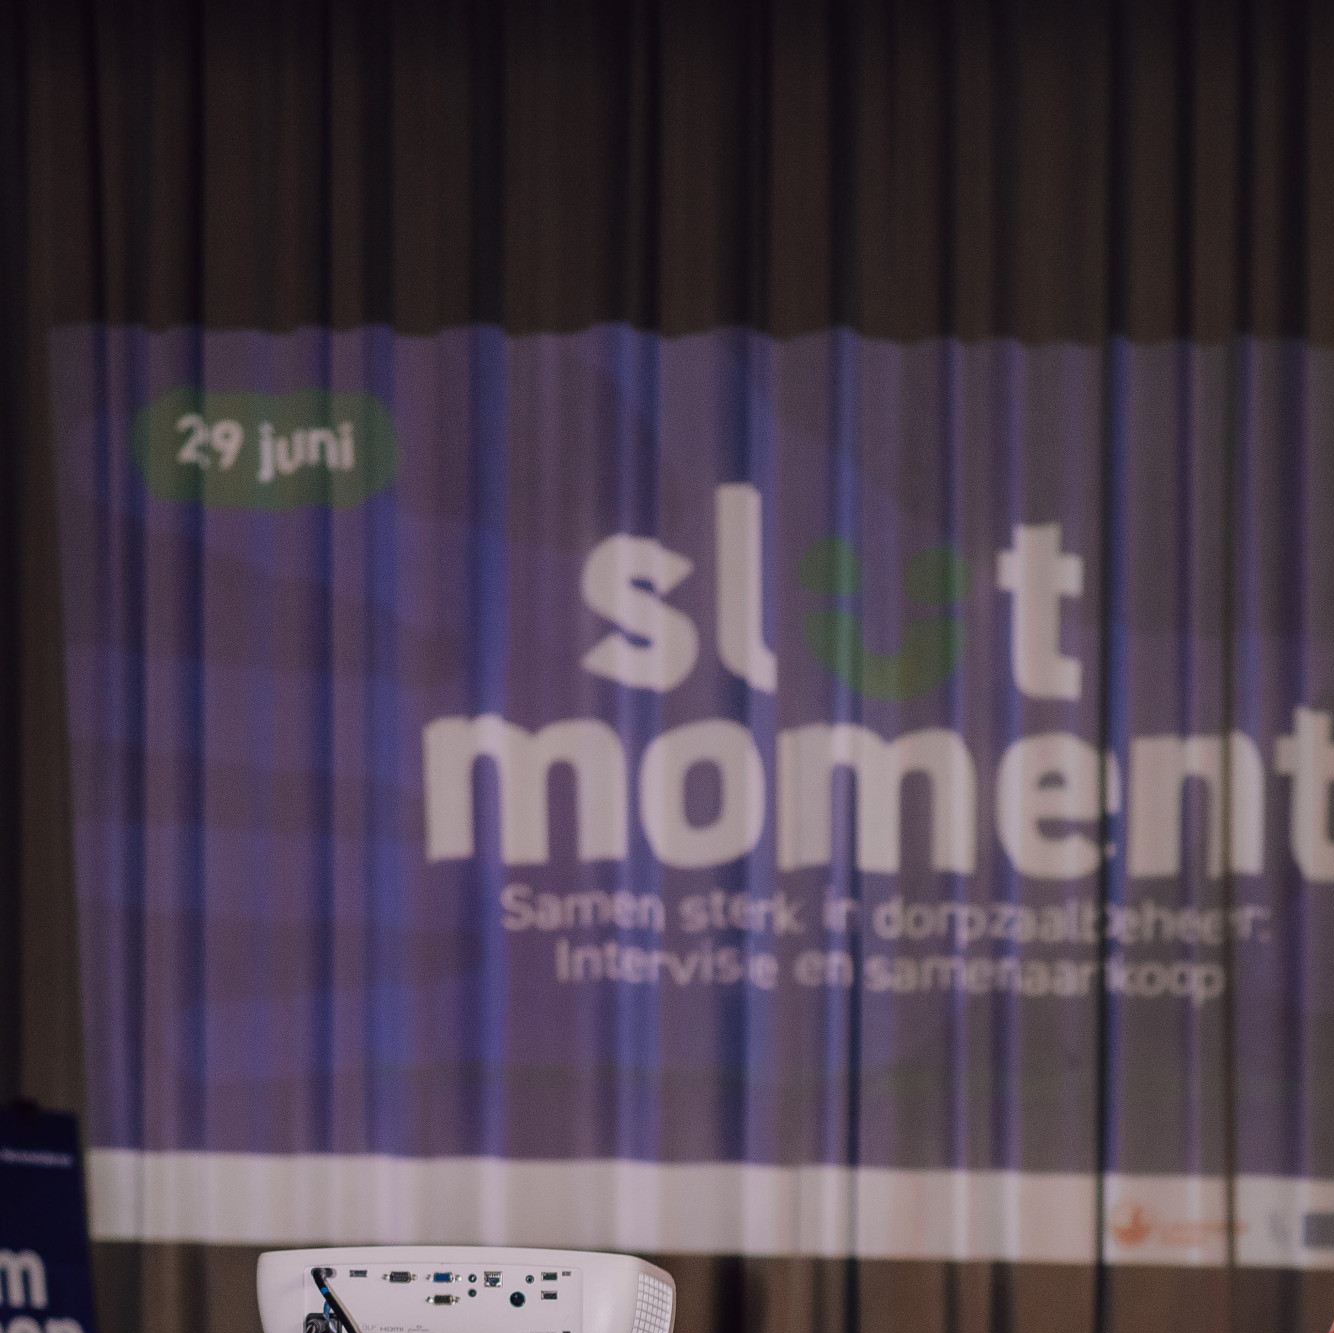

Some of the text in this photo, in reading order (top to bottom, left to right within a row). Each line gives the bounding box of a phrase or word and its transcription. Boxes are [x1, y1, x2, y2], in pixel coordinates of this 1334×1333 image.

[177, 413, 356, 483] 29 juni
[502, 883, 666, 933] Samen
[679, 888, 806, 937] sterk
[555, 937, 779, 990] Intervise
